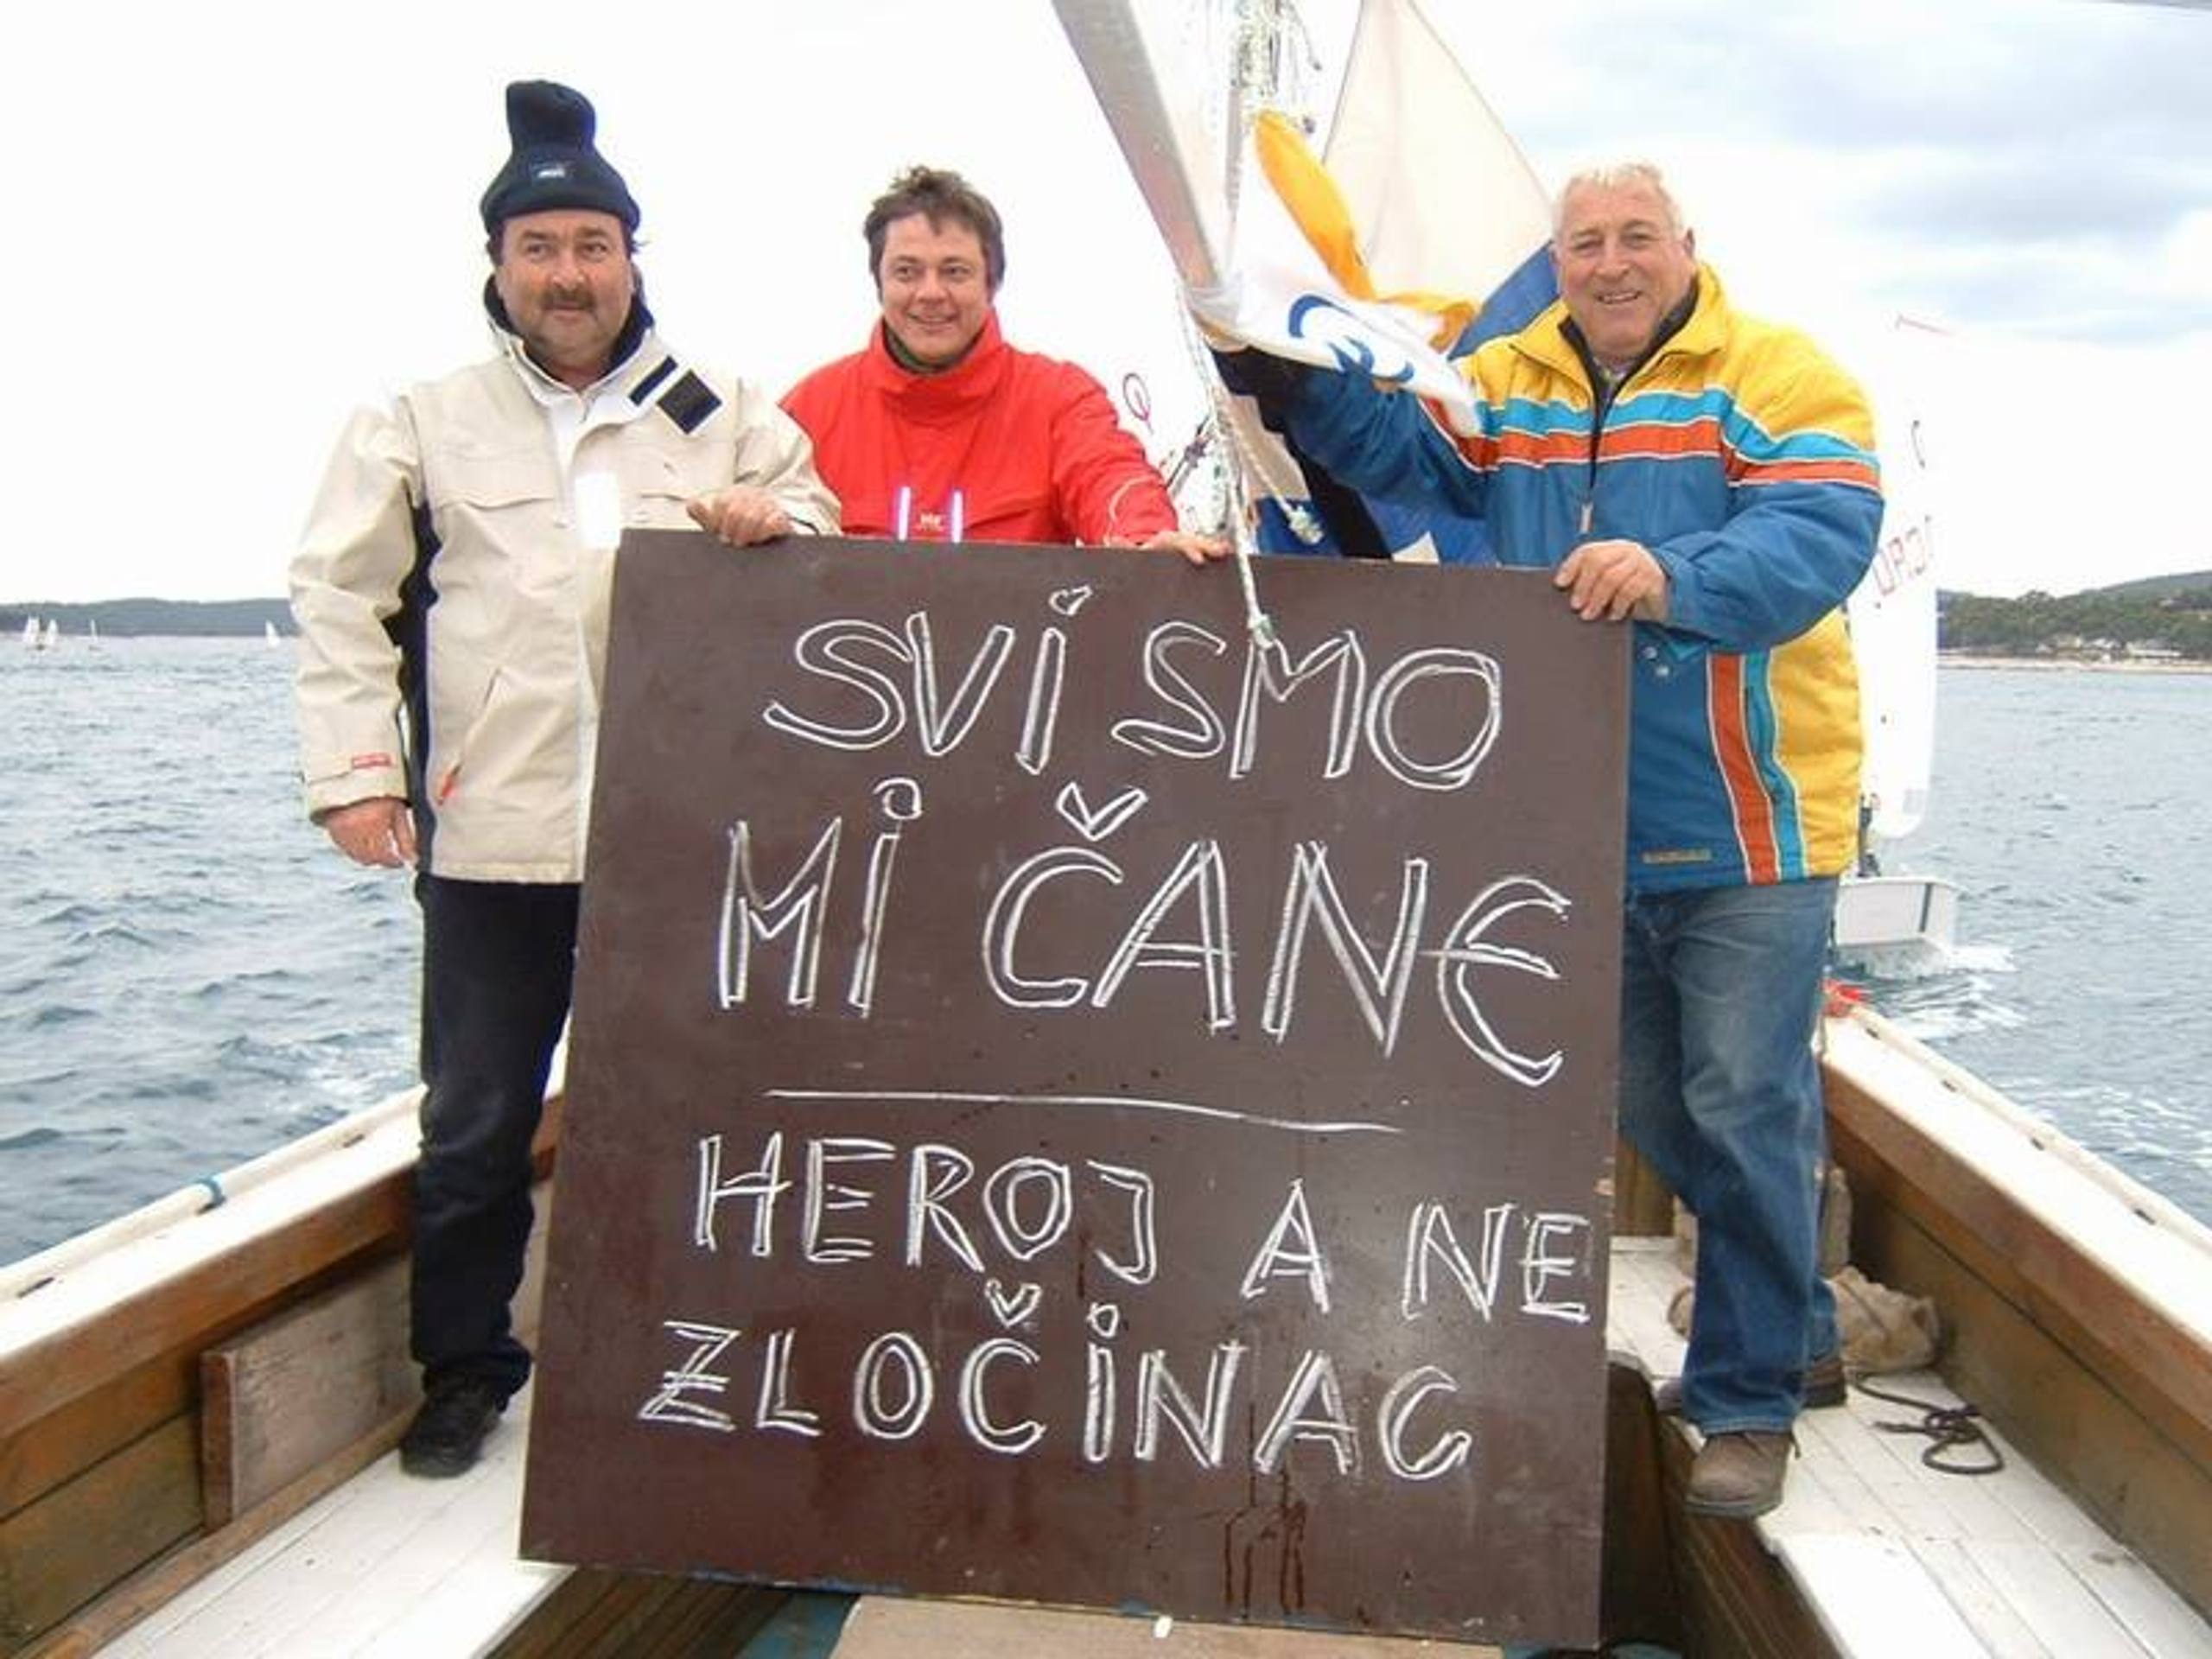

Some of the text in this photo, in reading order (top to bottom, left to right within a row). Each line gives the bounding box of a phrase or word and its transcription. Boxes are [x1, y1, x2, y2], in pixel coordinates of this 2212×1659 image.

[1111, 621, 1502, 791] SMO
[695, 1132, 1592, 1323] HEROJ A NE
